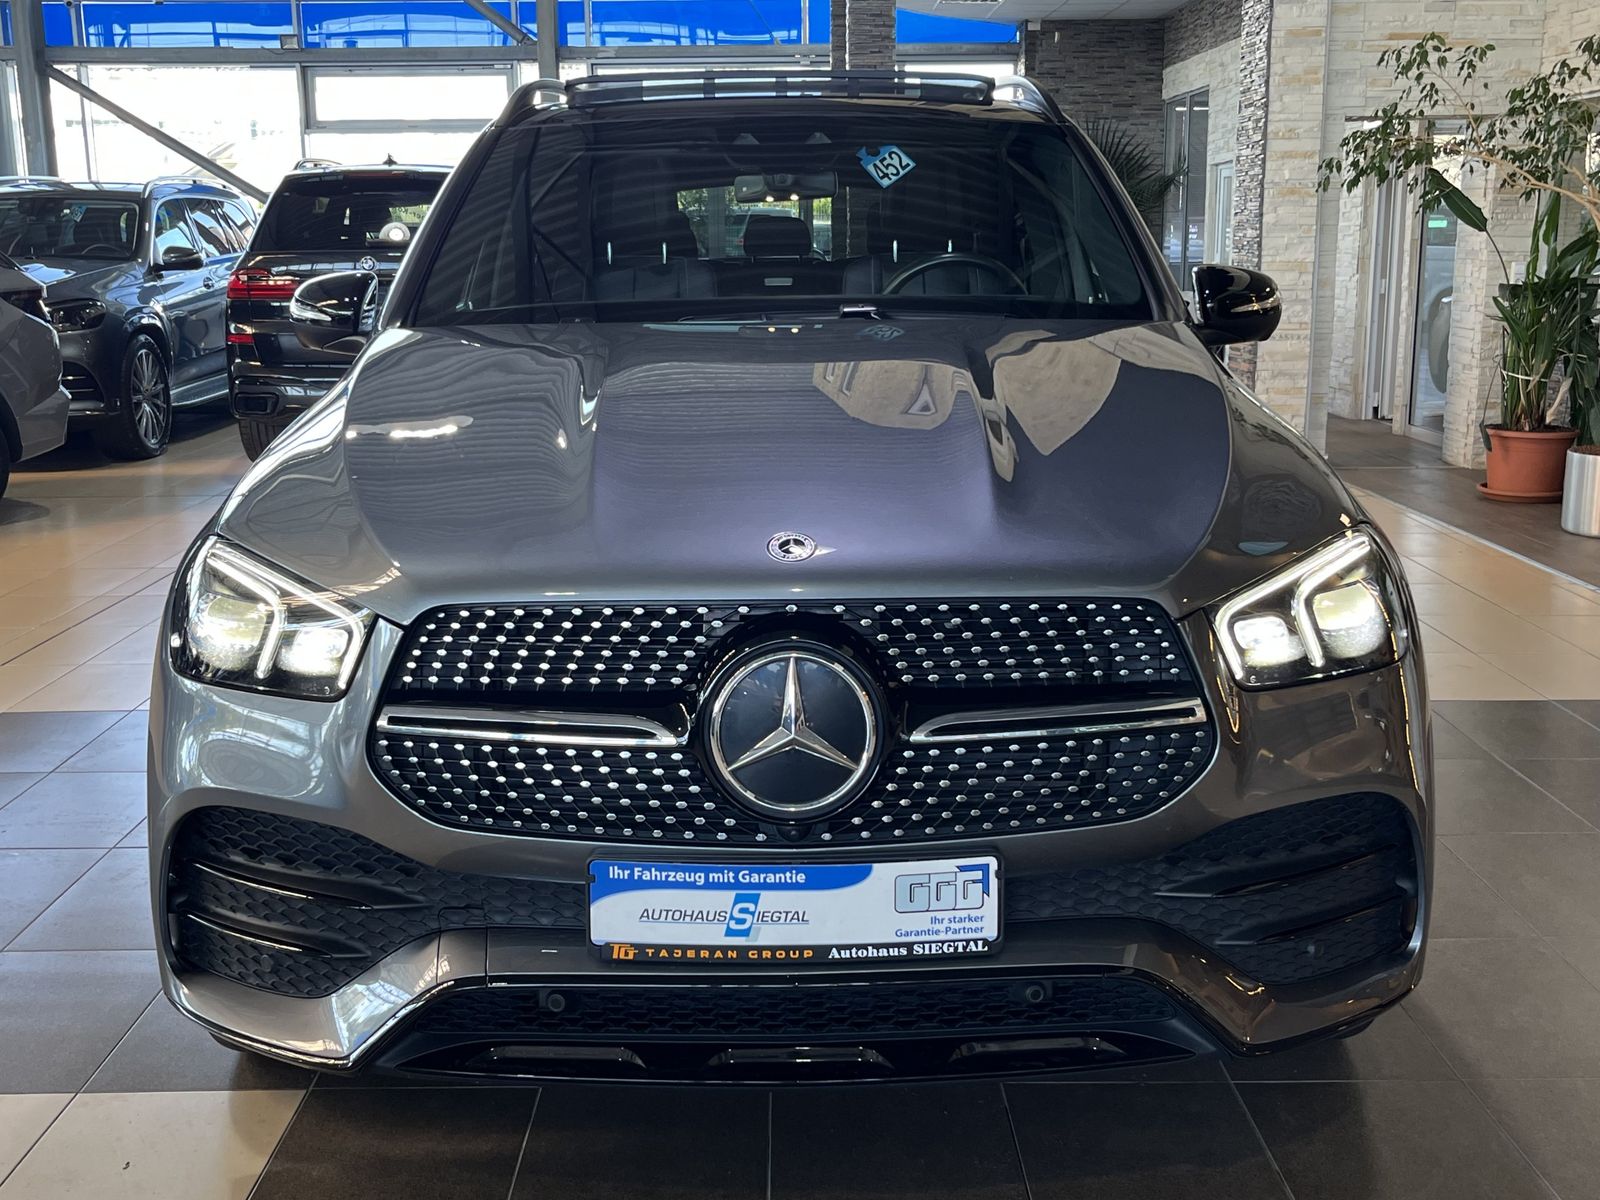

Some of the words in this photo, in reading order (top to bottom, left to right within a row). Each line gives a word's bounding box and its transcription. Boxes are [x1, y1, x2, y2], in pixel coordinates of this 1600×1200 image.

[872, 150, 911, 181] 452
[608, 865, 631, 880] Ihr
[633, 867, 705, 886] Fahrzeug
[708, 869, 735, 883] mit
[738, 870, 806, 884] Garantie
[638, 908, 728, 923] AUTOHAUS
[930, 915, 945, 926] Ihr
[947, 914, 985, 925] starker
[894, 925, 985, 938] Garantie-Partner
[645, 948, 738, 959] TAJERAN
[748, 949, 814, 959] GROUP
[827, 945, 908, 959] Autohaus
[912, 940, 988, 955] SIEGTAL
